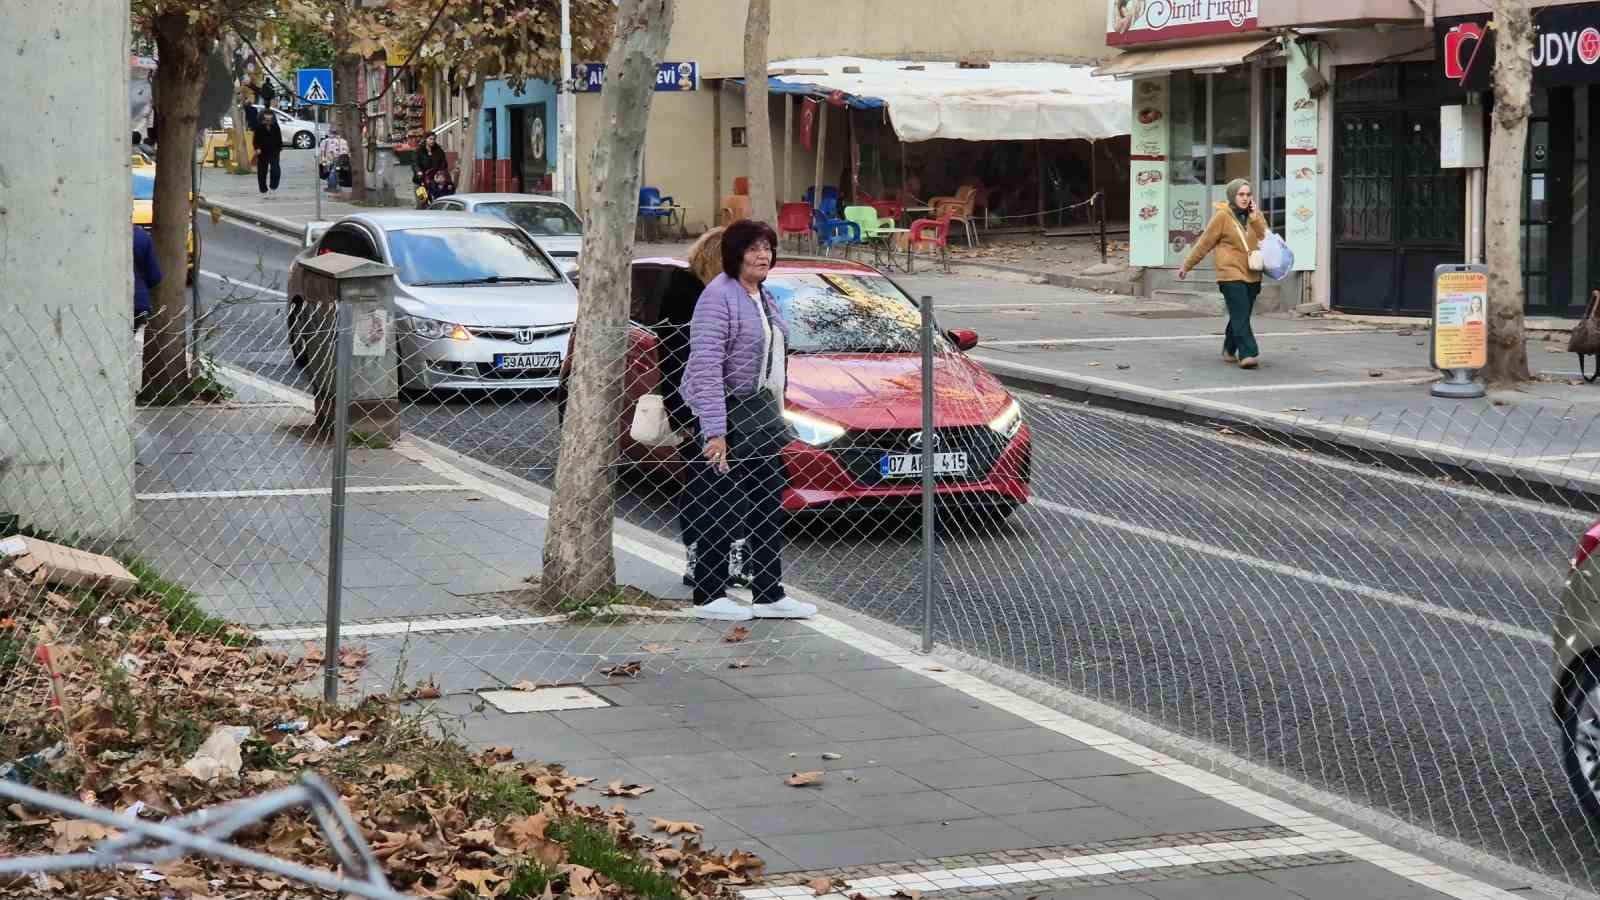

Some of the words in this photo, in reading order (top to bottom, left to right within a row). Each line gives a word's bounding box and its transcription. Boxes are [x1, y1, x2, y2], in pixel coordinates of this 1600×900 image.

[1531, 25, 1600, 66] ÜDYO
[656, 66, 675, 84] EVİ
[889, 457, 904, 472] 07
[942, 454, 966, 470] 415
